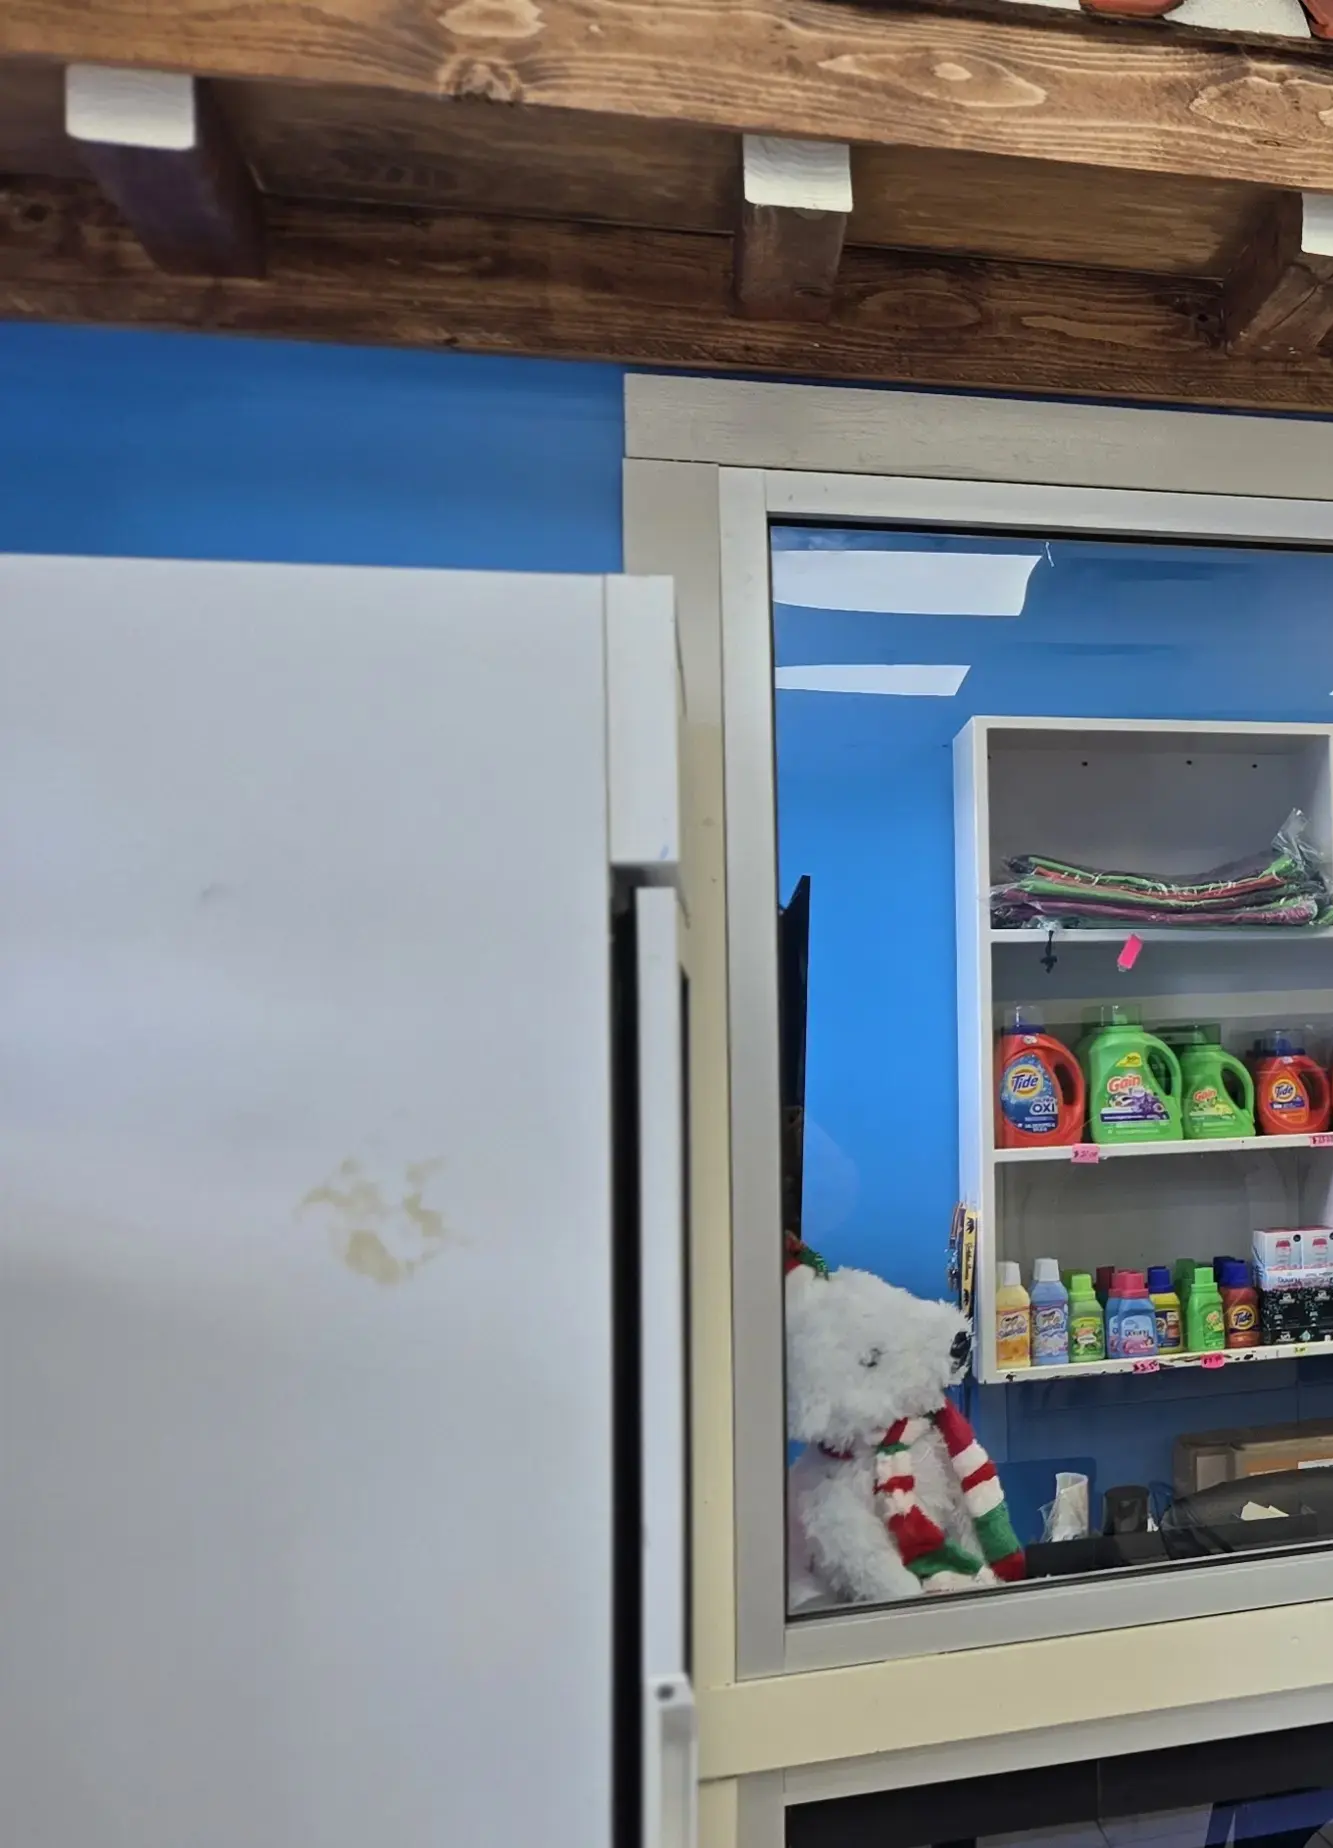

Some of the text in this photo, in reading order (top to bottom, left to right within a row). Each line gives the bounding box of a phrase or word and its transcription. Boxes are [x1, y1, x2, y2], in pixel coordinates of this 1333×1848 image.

[1012, 1072, 1039, 1092] Tide
[1108, 1074, 1141, 1092] Gain
[1275, 1080, 1296, 1096] Tide
[1194, 1088, 1217, 1101] Gain
[1032, 1101, 1056, 1113] OXI
